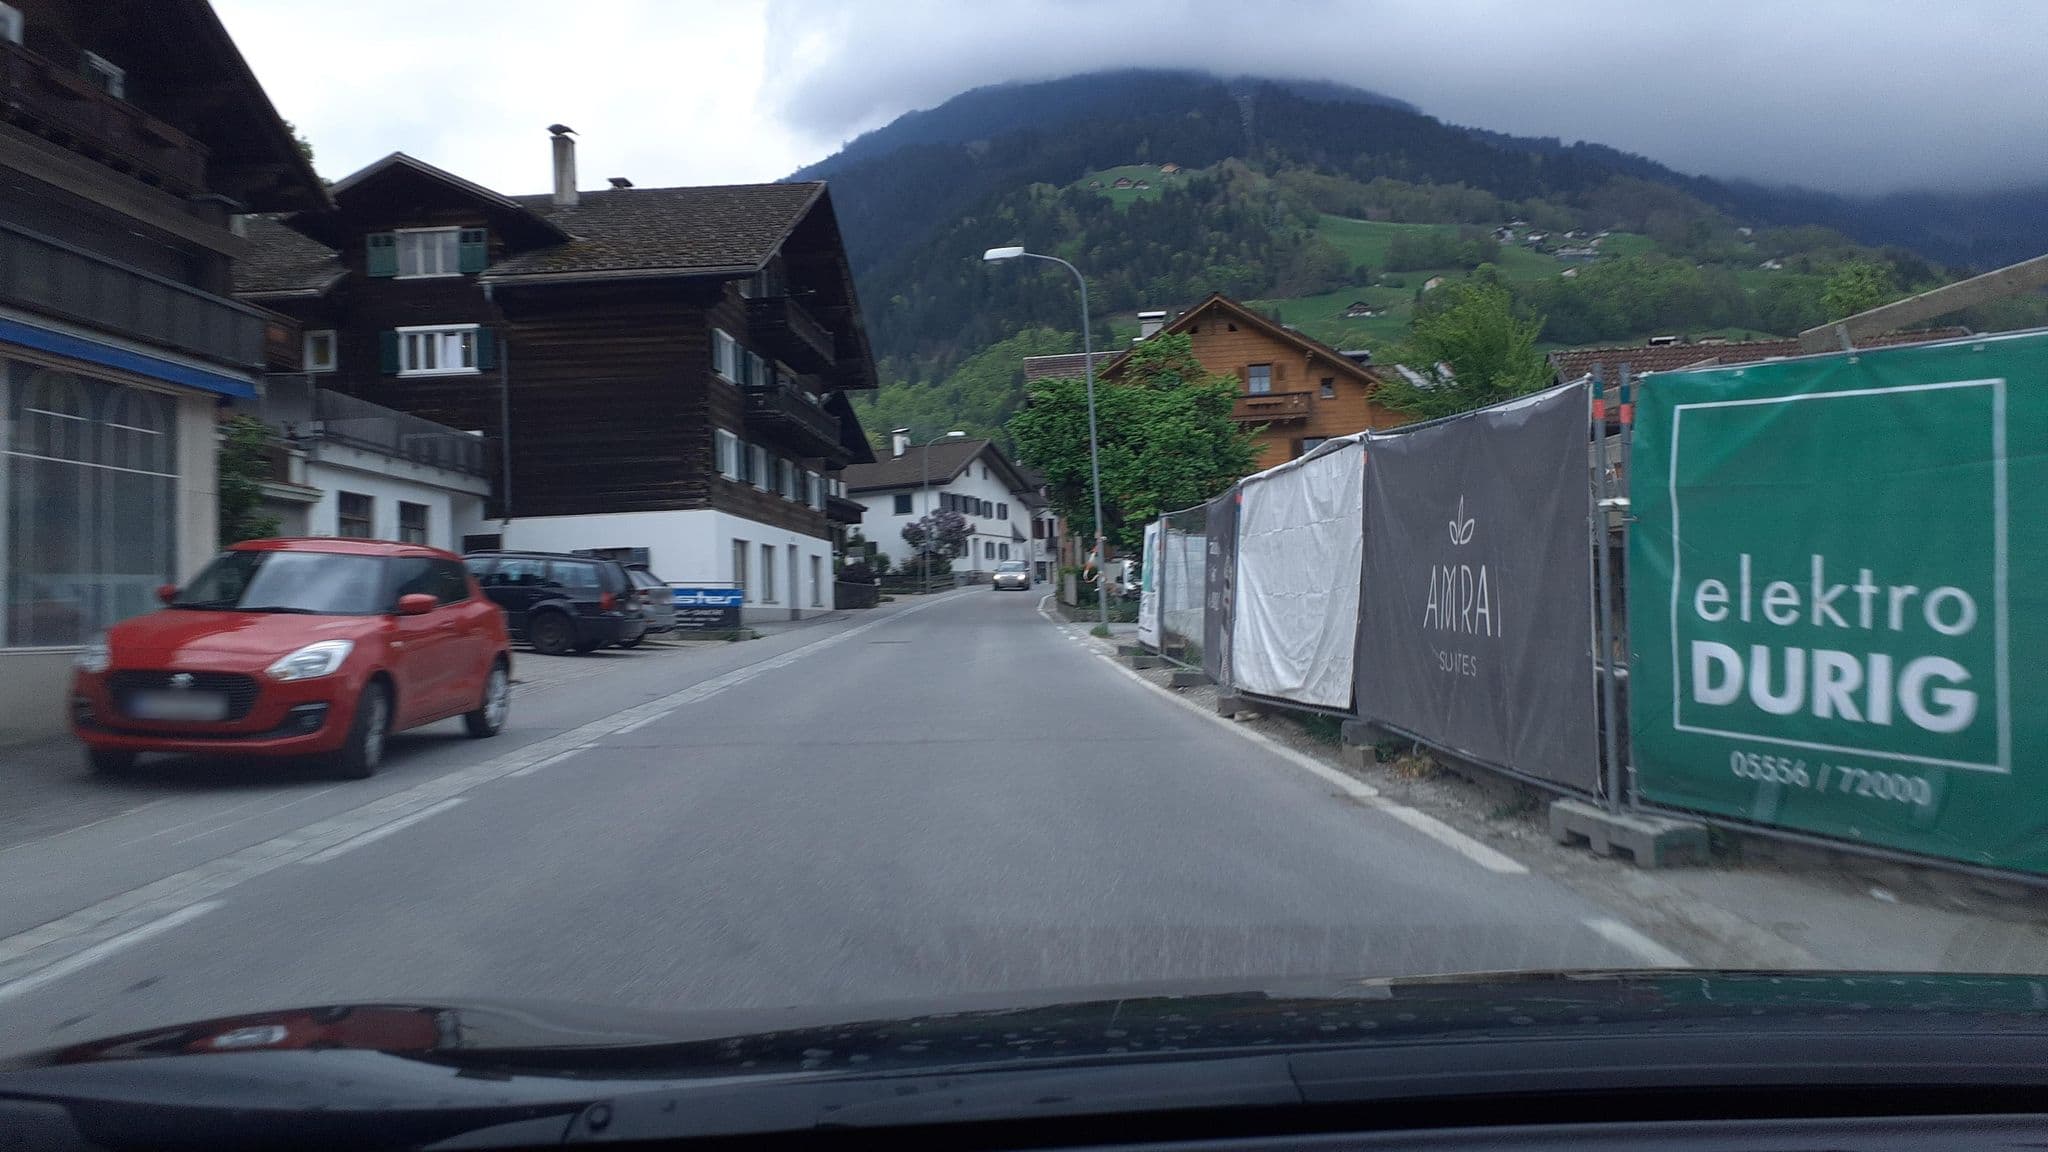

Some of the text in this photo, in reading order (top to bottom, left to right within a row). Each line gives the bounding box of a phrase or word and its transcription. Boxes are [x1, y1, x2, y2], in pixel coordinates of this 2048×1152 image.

[1694, 553, 1978, 636] elektro
[1439, 650, 1478, 677] SUITES
[1691, 640, 1979, 733] DURIG
[1730, 750, 1810, 789] 05556
[1836, 765, 1931, 806] 72000
